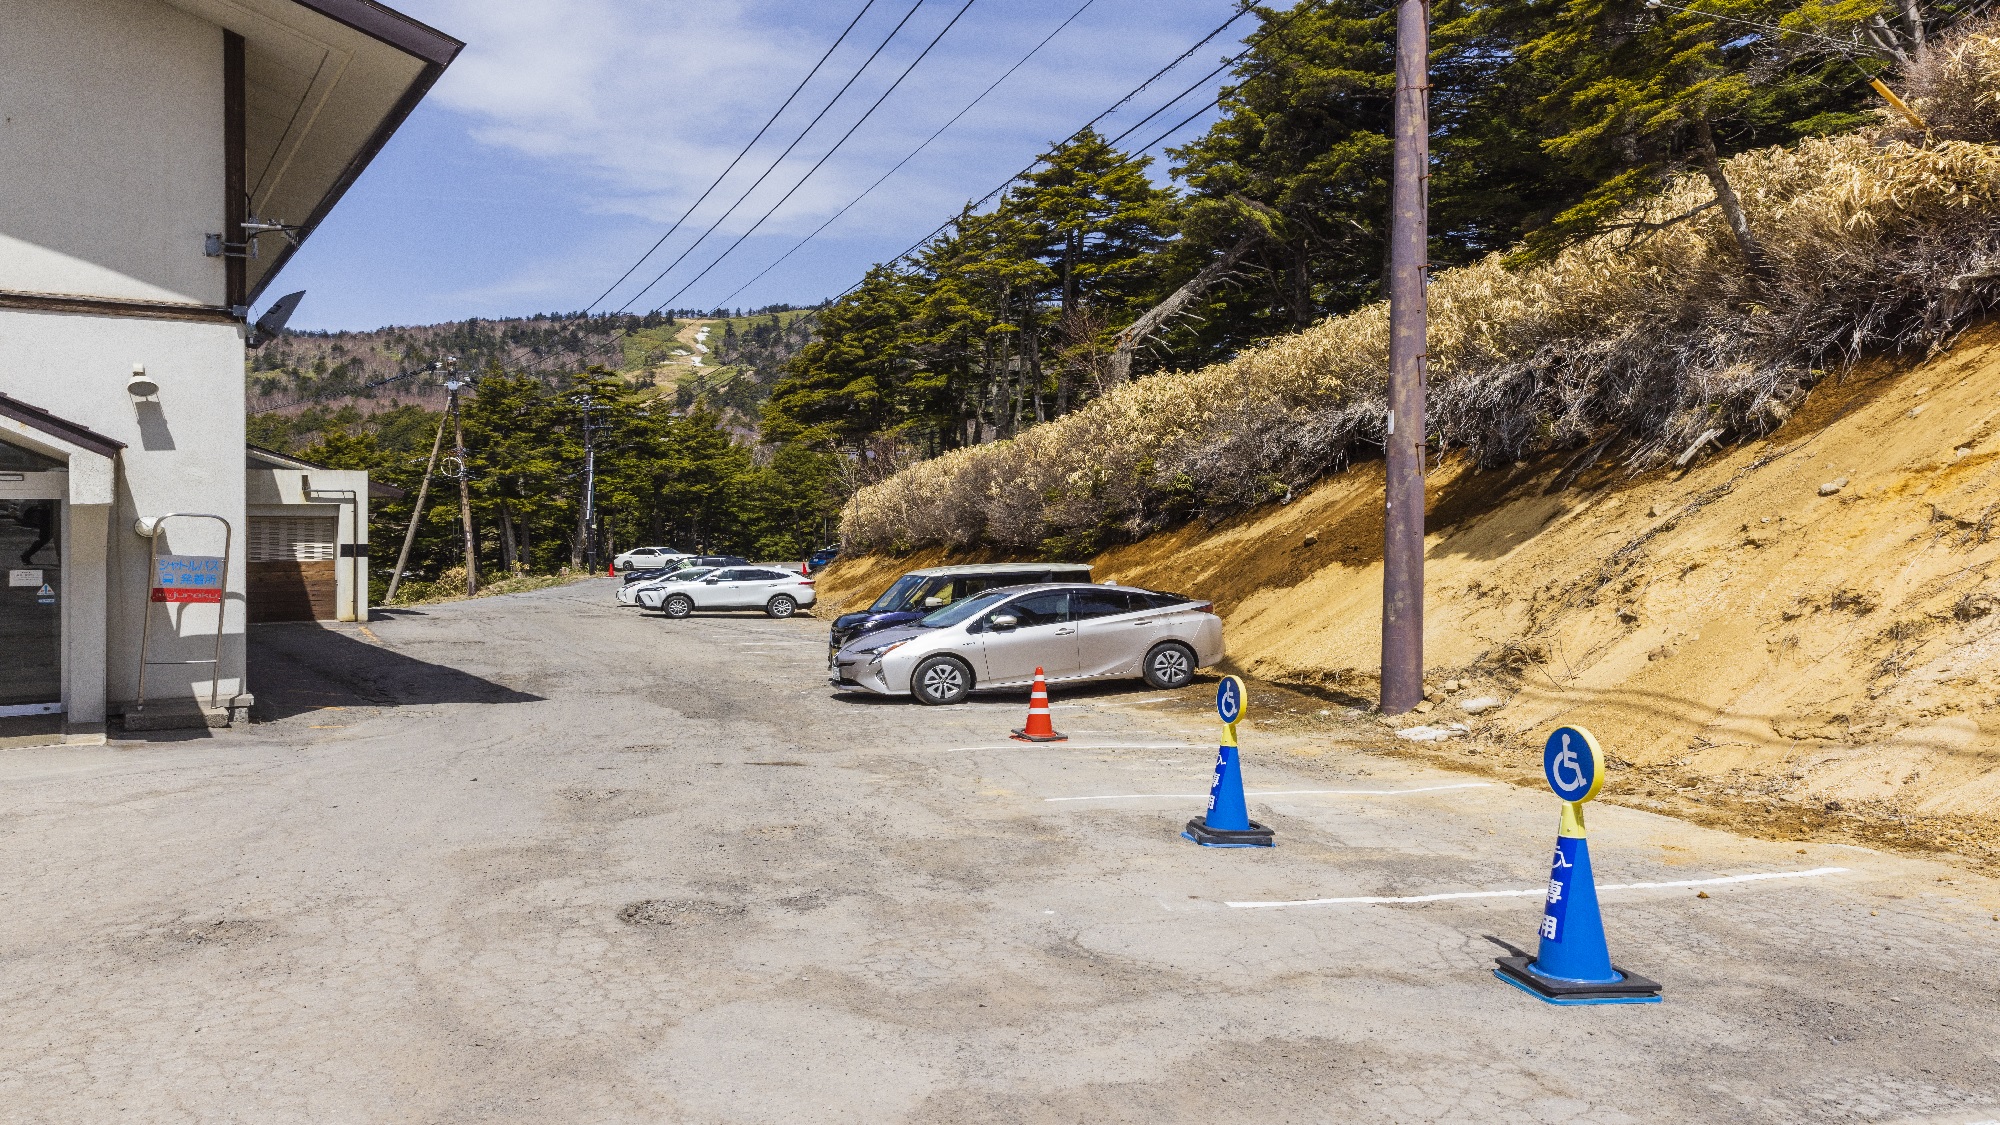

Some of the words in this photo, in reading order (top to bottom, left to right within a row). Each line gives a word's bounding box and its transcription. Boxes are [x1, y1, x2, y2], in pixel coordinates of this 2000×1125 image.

[159, 559, 219, 571] シャトルバス
